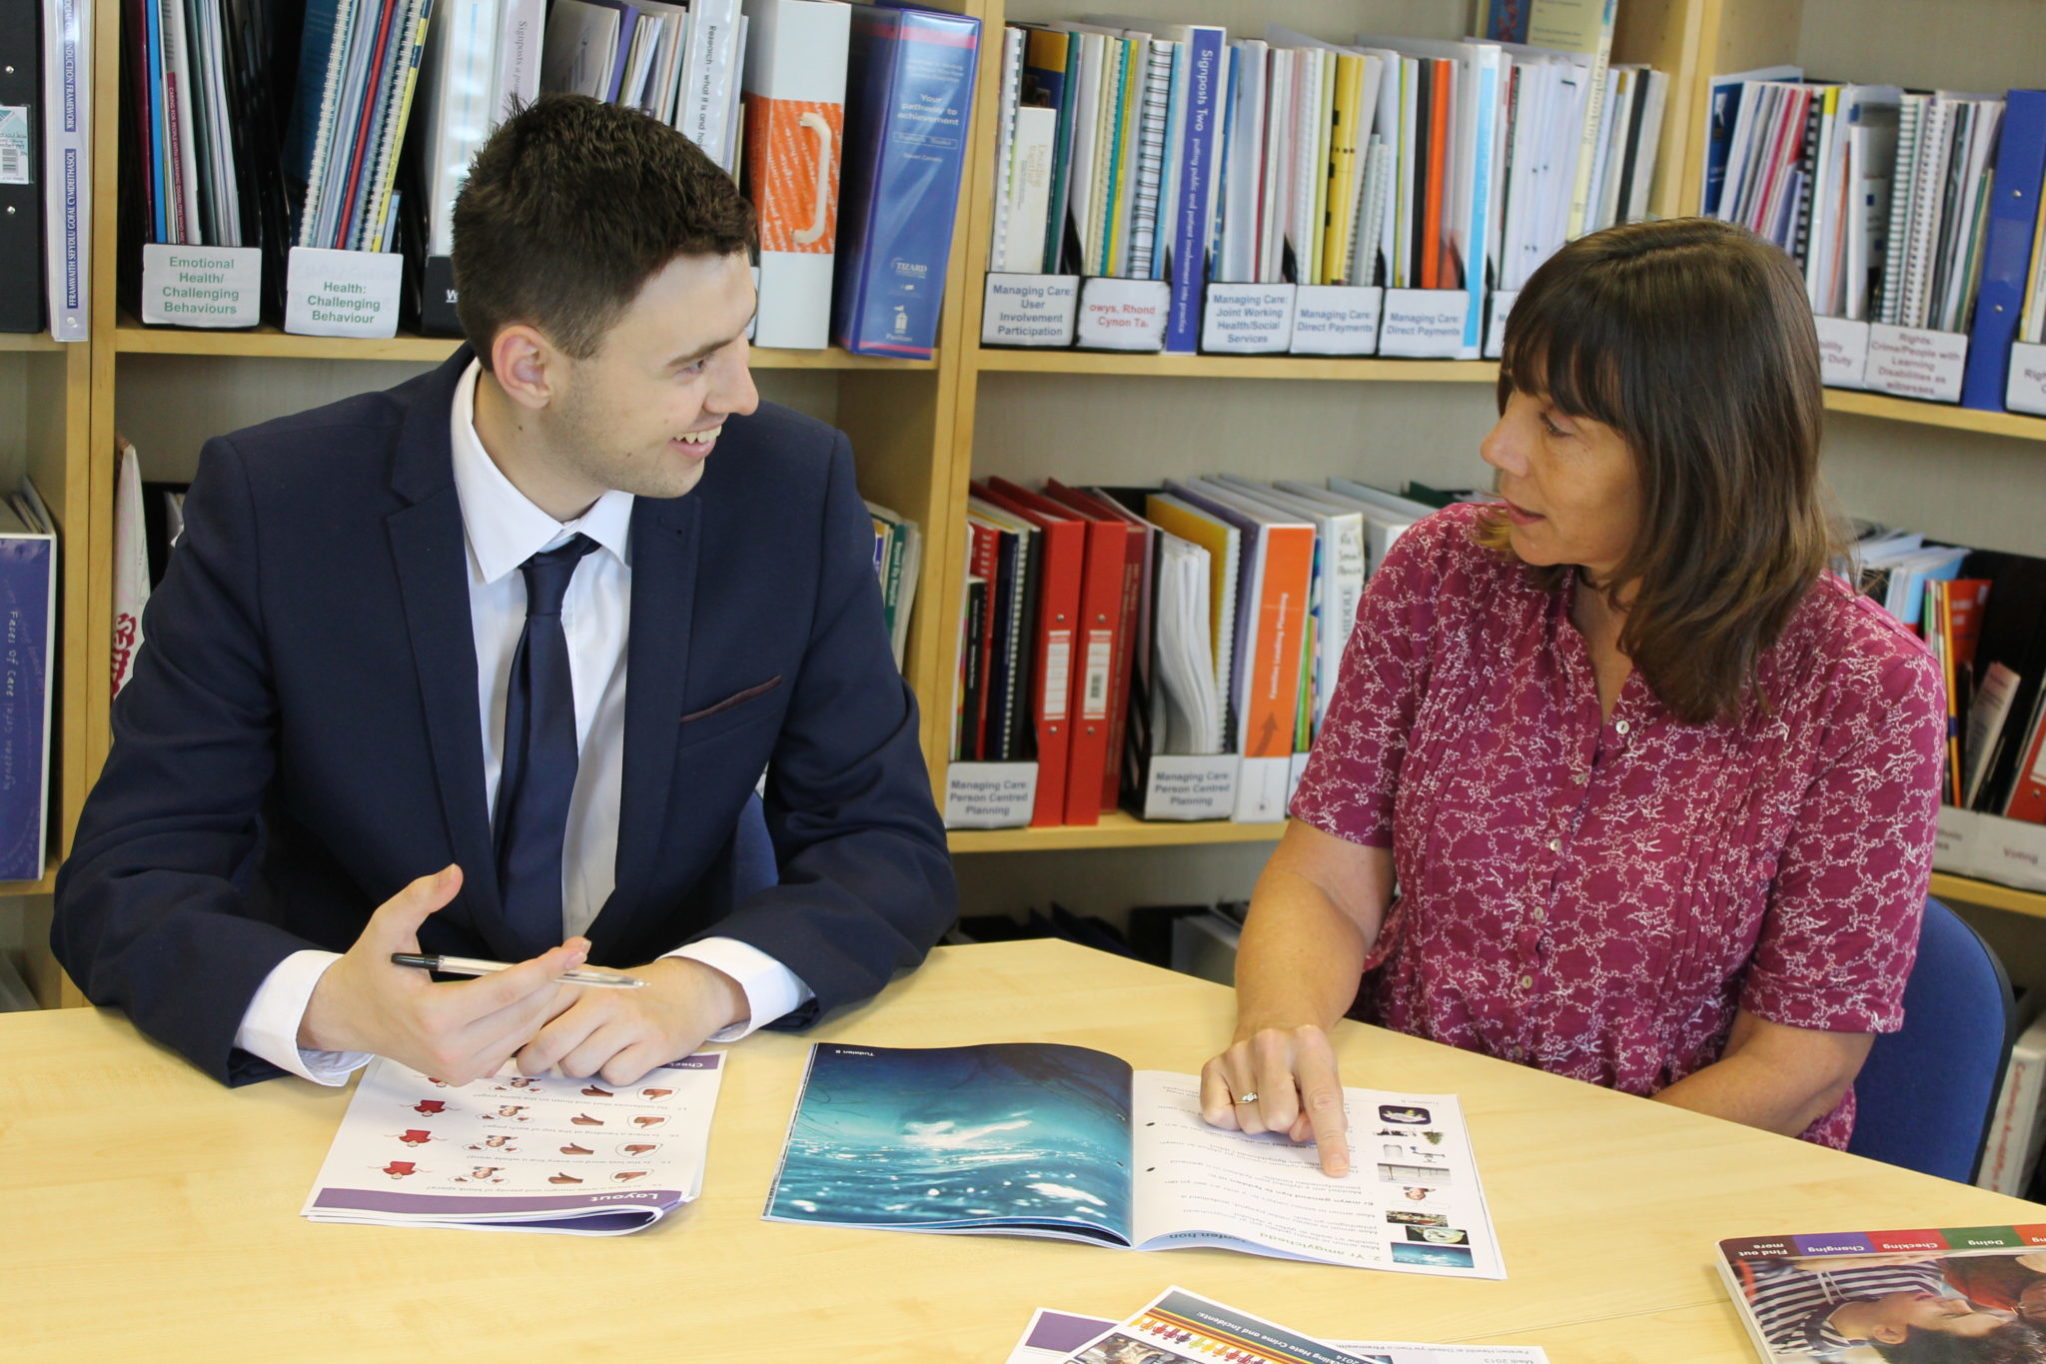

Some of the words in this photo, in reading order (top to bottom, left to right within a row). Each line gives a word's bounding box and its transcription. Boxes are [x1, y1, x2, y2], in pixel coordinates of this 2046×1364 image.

[705, 25, 717, 65] Research
[1196, 49, 1214, 105] Signposts
[702, 74, 711, 96] what
[920, 93, 944, 103] Your
[65, 85, 75, 129] FRAMEWORK
[947, 107, 958, 116] to
[698, 113, 707, 130] and
[897, 111, 960, 126] achievement
[1194, 108, 1209, 132] Two
[1191, 138, 1202, 166] putting
[1189, 167, 1201, 192] public
[1189, 193, 1198, 209] and
[67, 207, 76, 229] GOFAL
[1186, 210, 1196, 238] patient
[169, 256, 234, 269] Emotional
[896, 262, 928, 272] TIZARD
[1182, 239, 1195, 285] involvement
[179, 272, 225, 283] Health/
[162, 286, 239, 302] Challenging
[993, 285, 1044, 297] Managing
[307, 295, 381, 312] Challenging
[1021, 299, 1045, 309] User
[1213, 295, 1261, 305] Managing
[164, 301, 237, 314] Behaviours
[1216, 308, 1241, 317] Joint
[1244, 308, 1283, 318] Working
[312, 310, 375, 323] Behaviour
[1000, 312, 1063, 323] Involvement
[1178, 302, 1188, 334] practice
[1300, 309, 1347, 320] Managing
[1391, 313, 1435, 324] Managing
[1098, 316, 1131, 327] Cynon
[1217, 321, 1280, 330] Health/Social
[1297, 321, 1326, 331] Direct
[1329, 322, 1373, 333] Payments
[998, 325, 1063, 337] Participation
[1387, 325, 1415, 334] Direct
[1418, 326, 1461, 337] Payments
[1227, 334, 1268, 343] Services
[1939, 351, 1961, 360] with
[1891, 356, 1936, 372] Learning
[7, 610, 18, 644] Faces
[1155, 771, 1204, 783] Managing
[951, 780, 1001, 792] Managing
[1155, 784, 1190, 793] Person
[1192, 783, 1231, 793] Centred
[950, 792, 986, 802] Person
[989, 792, 1028, 802] Centred
[1170, 796, 1213, 806] Planning
[965, 805, 1010, 816] Planning
[589, 1191, 659, 1202] Layout
[1752, 1242, 1785, 1250] more
[1882, 1242, 1938, 1252] Checking
[1968, 1239, 2005, 1247] Doing
[1738, 1249, 1758, 1257] out
[1761, 1248, 1788, 1257] Find
[1807, 1244, 1866, 1255] Changing
[1241, 1328, 1261, 1338] and
[1261, 1334, 1288, 1348] Crime
